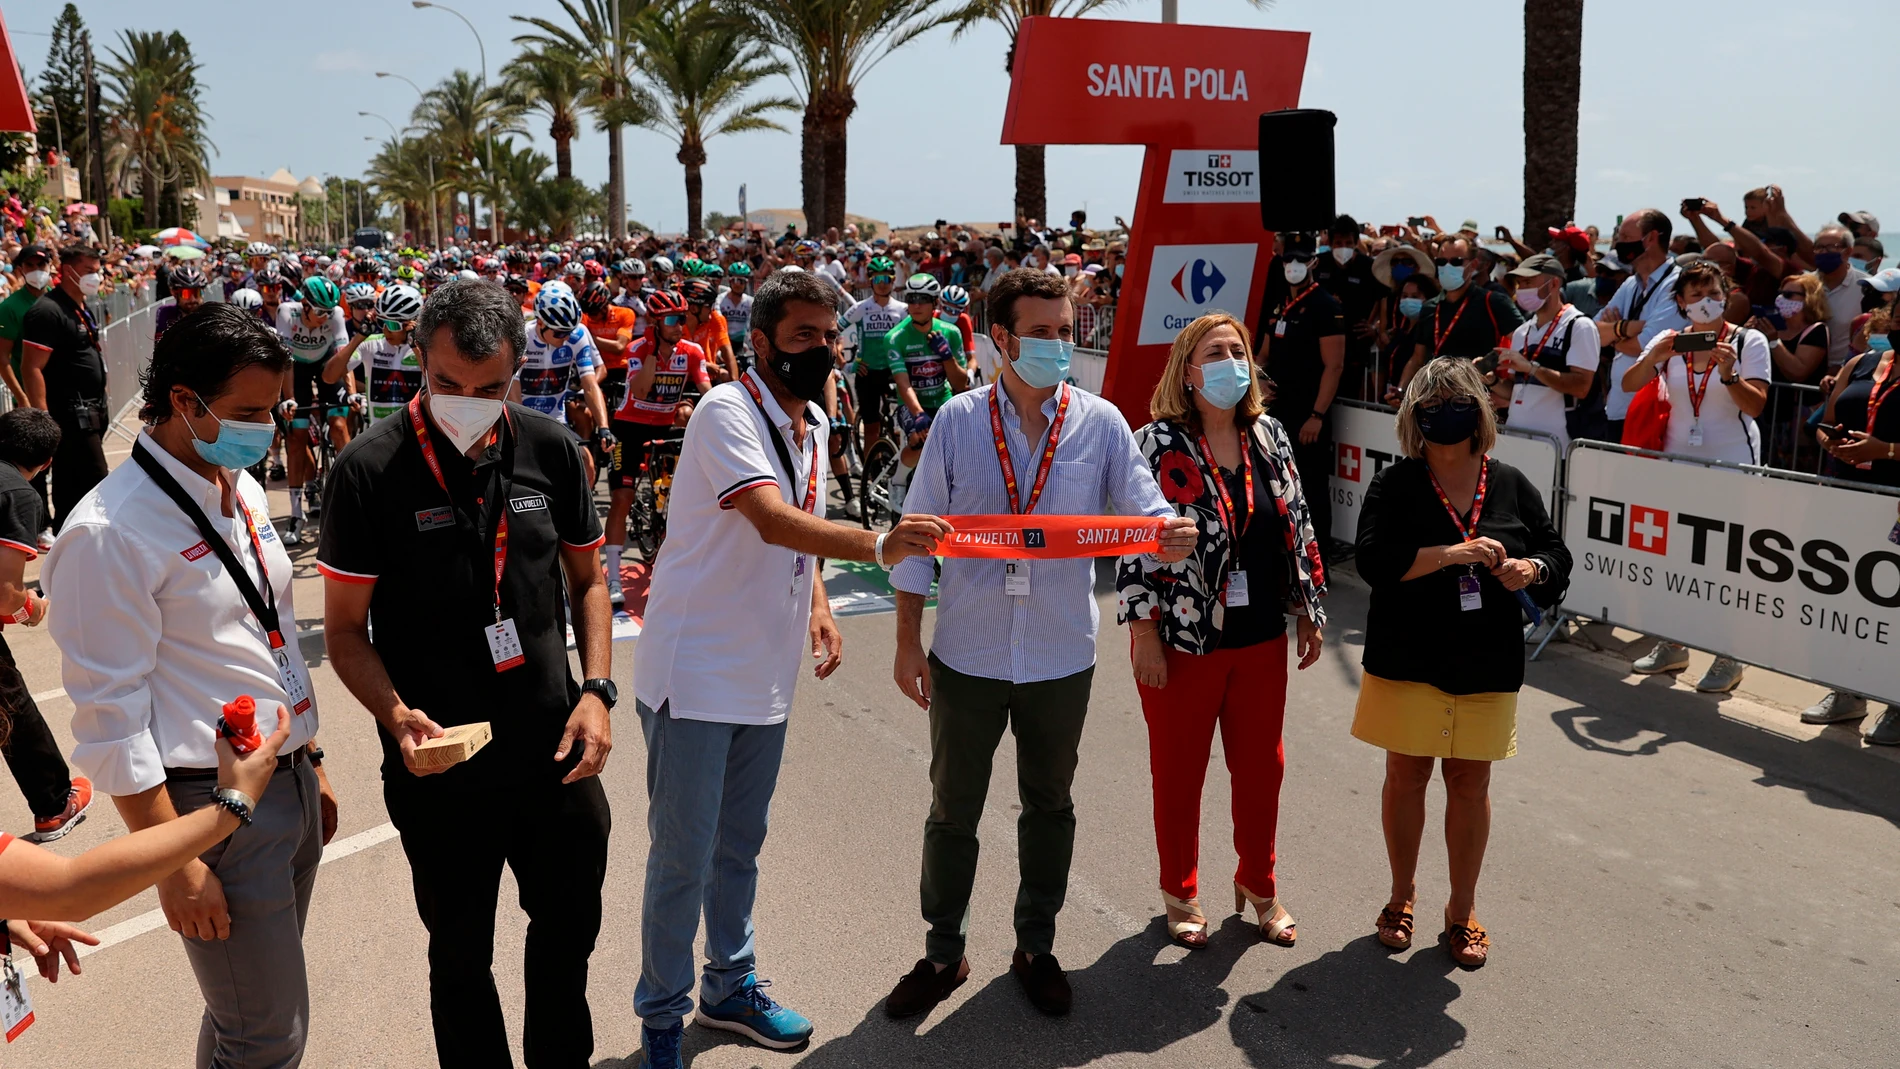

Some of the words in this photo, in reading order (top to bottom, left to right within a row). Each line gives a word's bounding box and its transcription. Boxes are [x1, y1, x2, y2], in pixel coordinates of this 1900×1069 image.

[1087, 63, 1175, 99] SANTA
[1184, 67, 1249, 101] POLA
[1183, 171, 1254, 187] TISSOT
[869, 313, 893, 322] CAJA
[293, 333, 327, 345] BORA
[373, 379, 418, 388] GRENADIER
[911, 377, 944, 388] FENIX
[515, 501, 524, 509] LA
[523, 499, 543, 508] VUELTA
[1592, 501, 1622, 539] T
[955, 534, 972, 543] LA
[974, 532, 1019, 545] VUELTA
[1028, 532, 1041, 545] 21
[1076, 528, 1119, 545] SANTA
[1123, 528, 1158, 543] POLA
[184, 551, 195, 560] LA
[189, 544, 209, 557] VUELTA
[1677, 512, 1900, 608] TISSO
[1584, 552, 1653, 586] SWISS
[1666, 571, 1785, 619] WATCHES
[1800, 604, 1891, 645] SINCE
